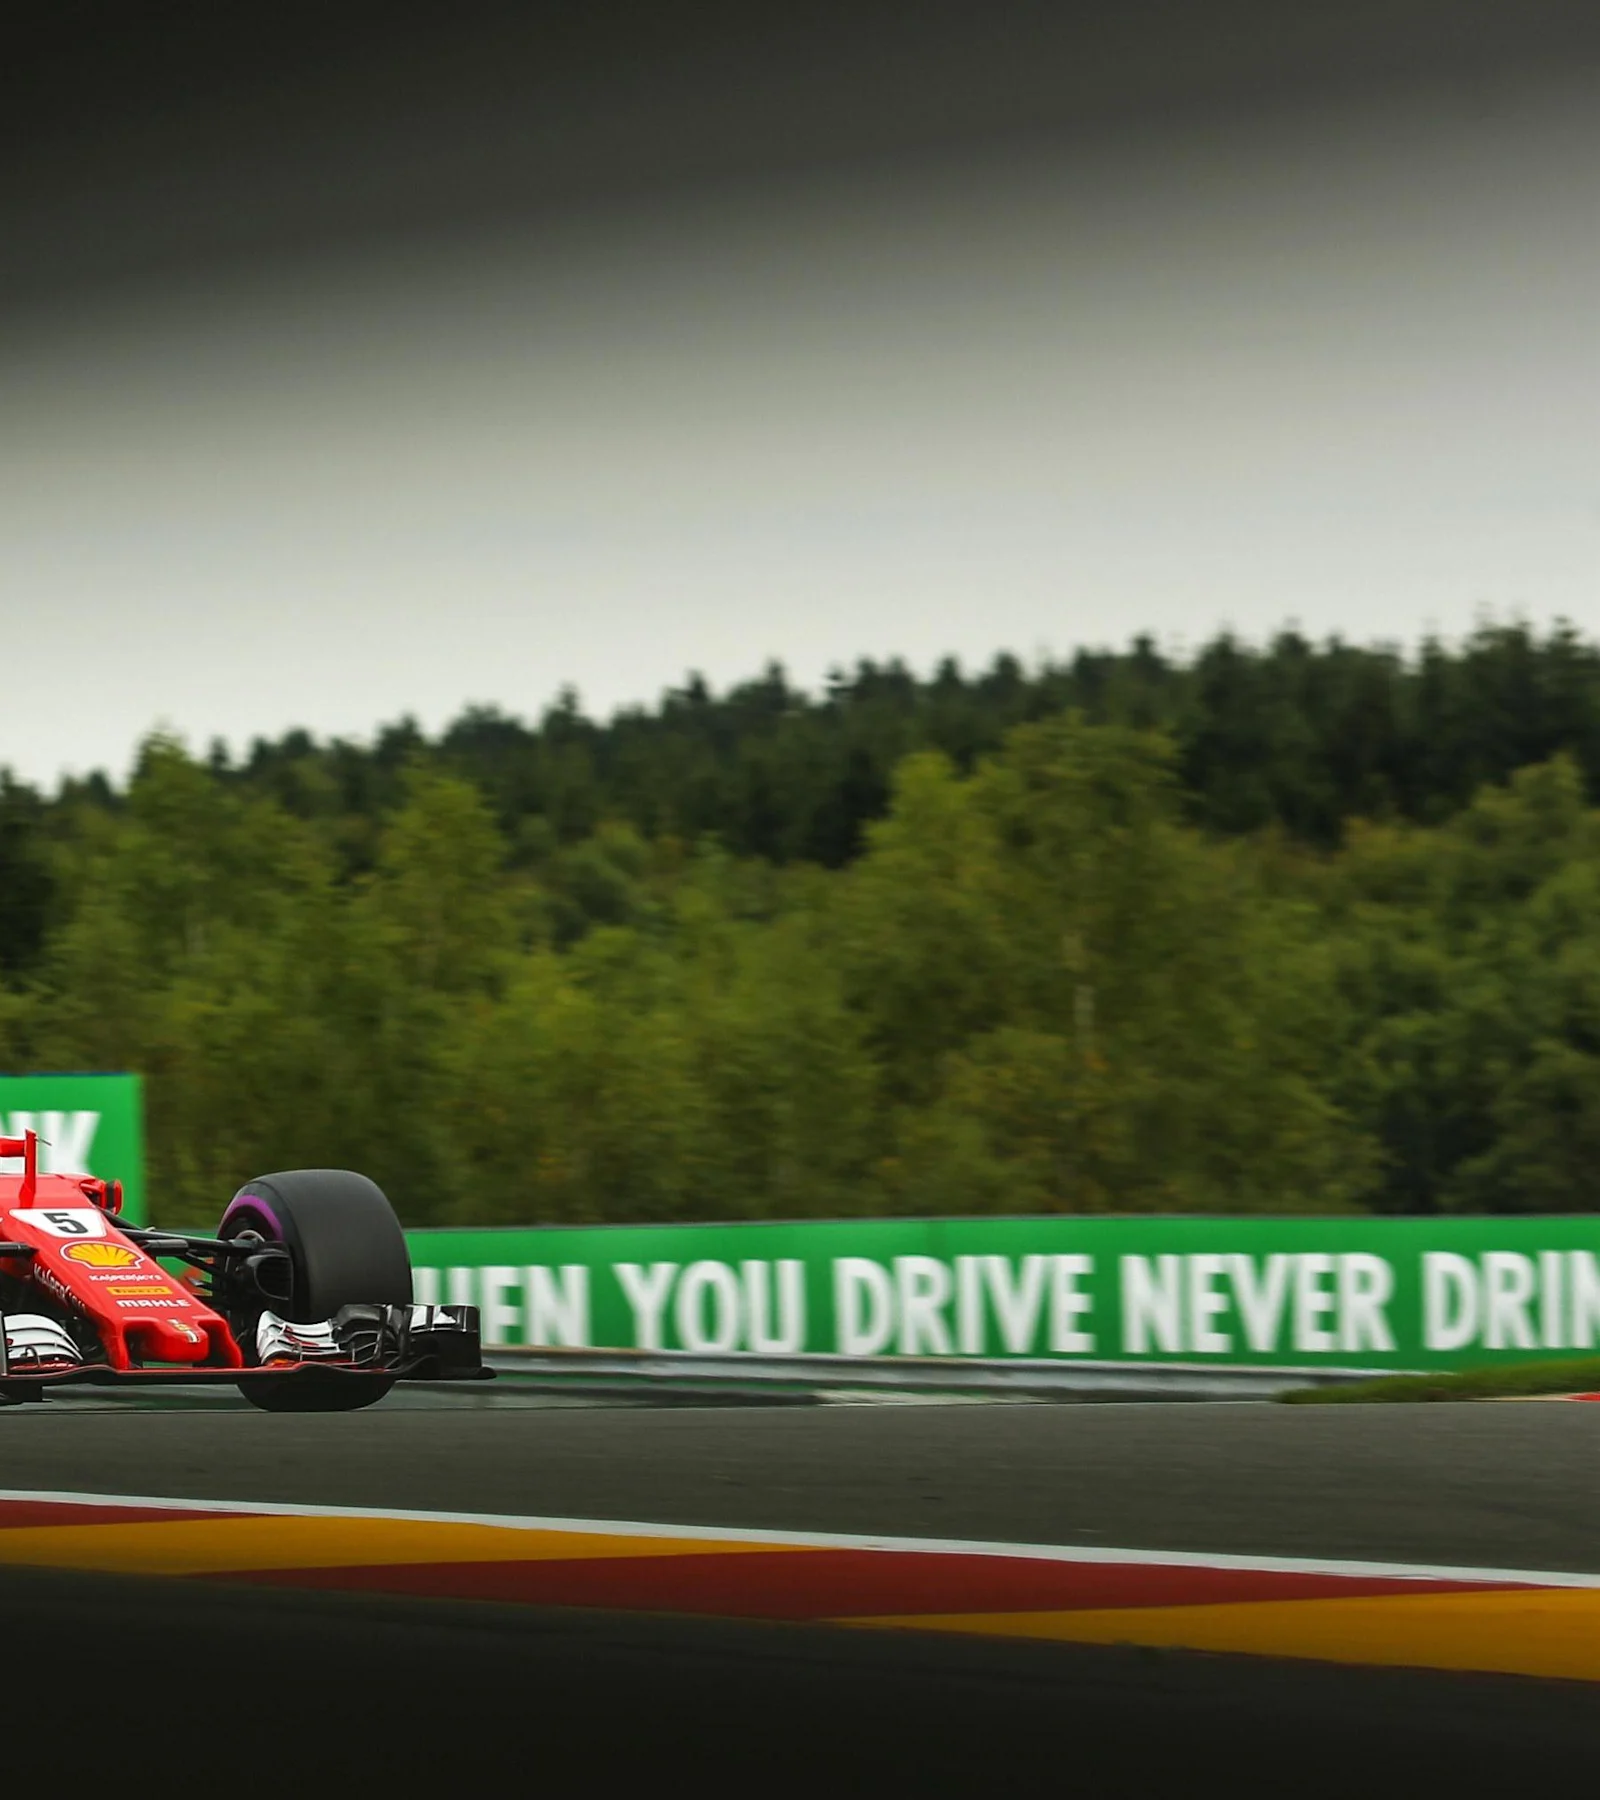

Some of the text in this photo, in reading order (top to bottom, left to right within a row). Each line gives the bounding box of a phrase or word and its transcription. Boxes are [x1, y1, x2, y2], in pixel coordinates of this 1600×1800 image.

[42, 1212, 89, 1234] 5
[116, 1299, 192, 1308] MAHLE
[612, 1260, 808, 1353] YOU
[832, 1254, 1096, 1356] DRIVE
[1120, 1252, 1397, 1353] NEVER
